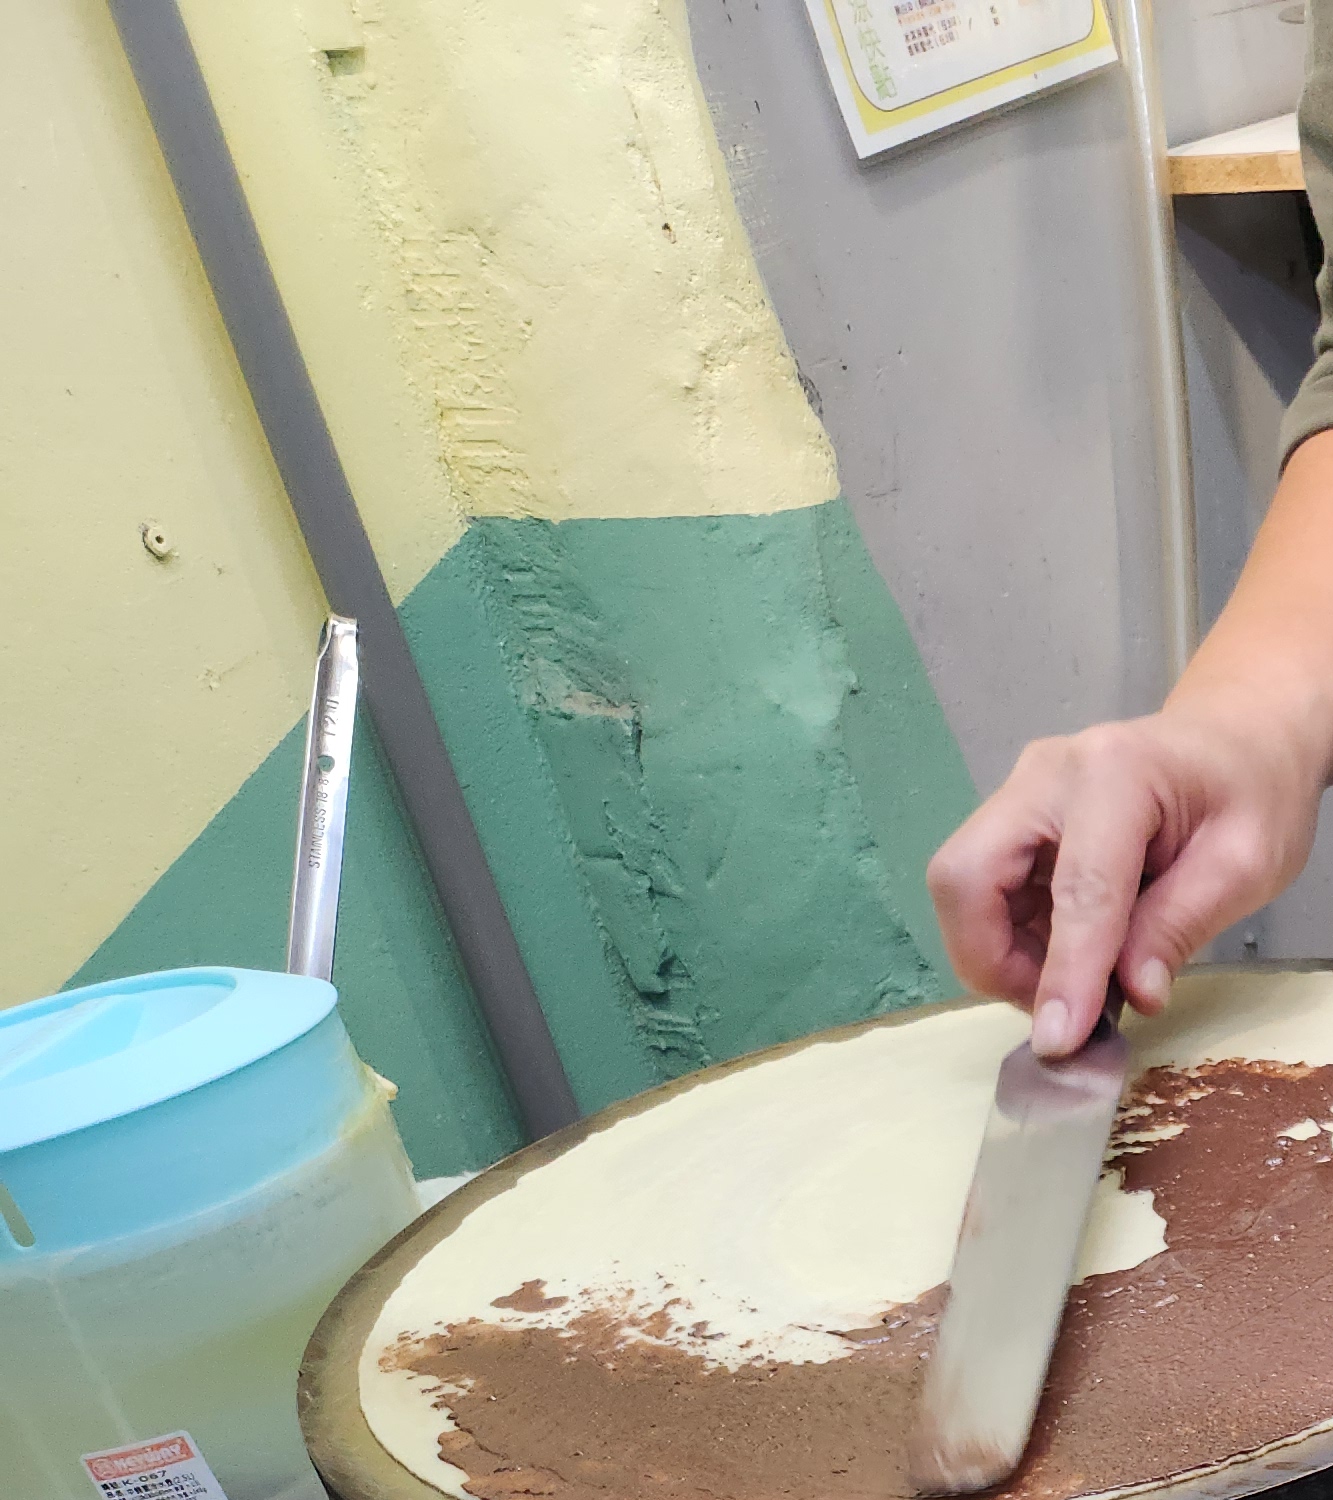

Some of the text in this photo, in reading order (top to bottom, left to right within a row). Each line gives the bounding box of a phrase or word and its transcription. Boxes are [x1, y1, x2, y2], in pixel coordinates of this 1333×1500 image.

[308, 777, 330, 869] STAINLESS 18-8
[121, 1469, 168, 1486] K-067
